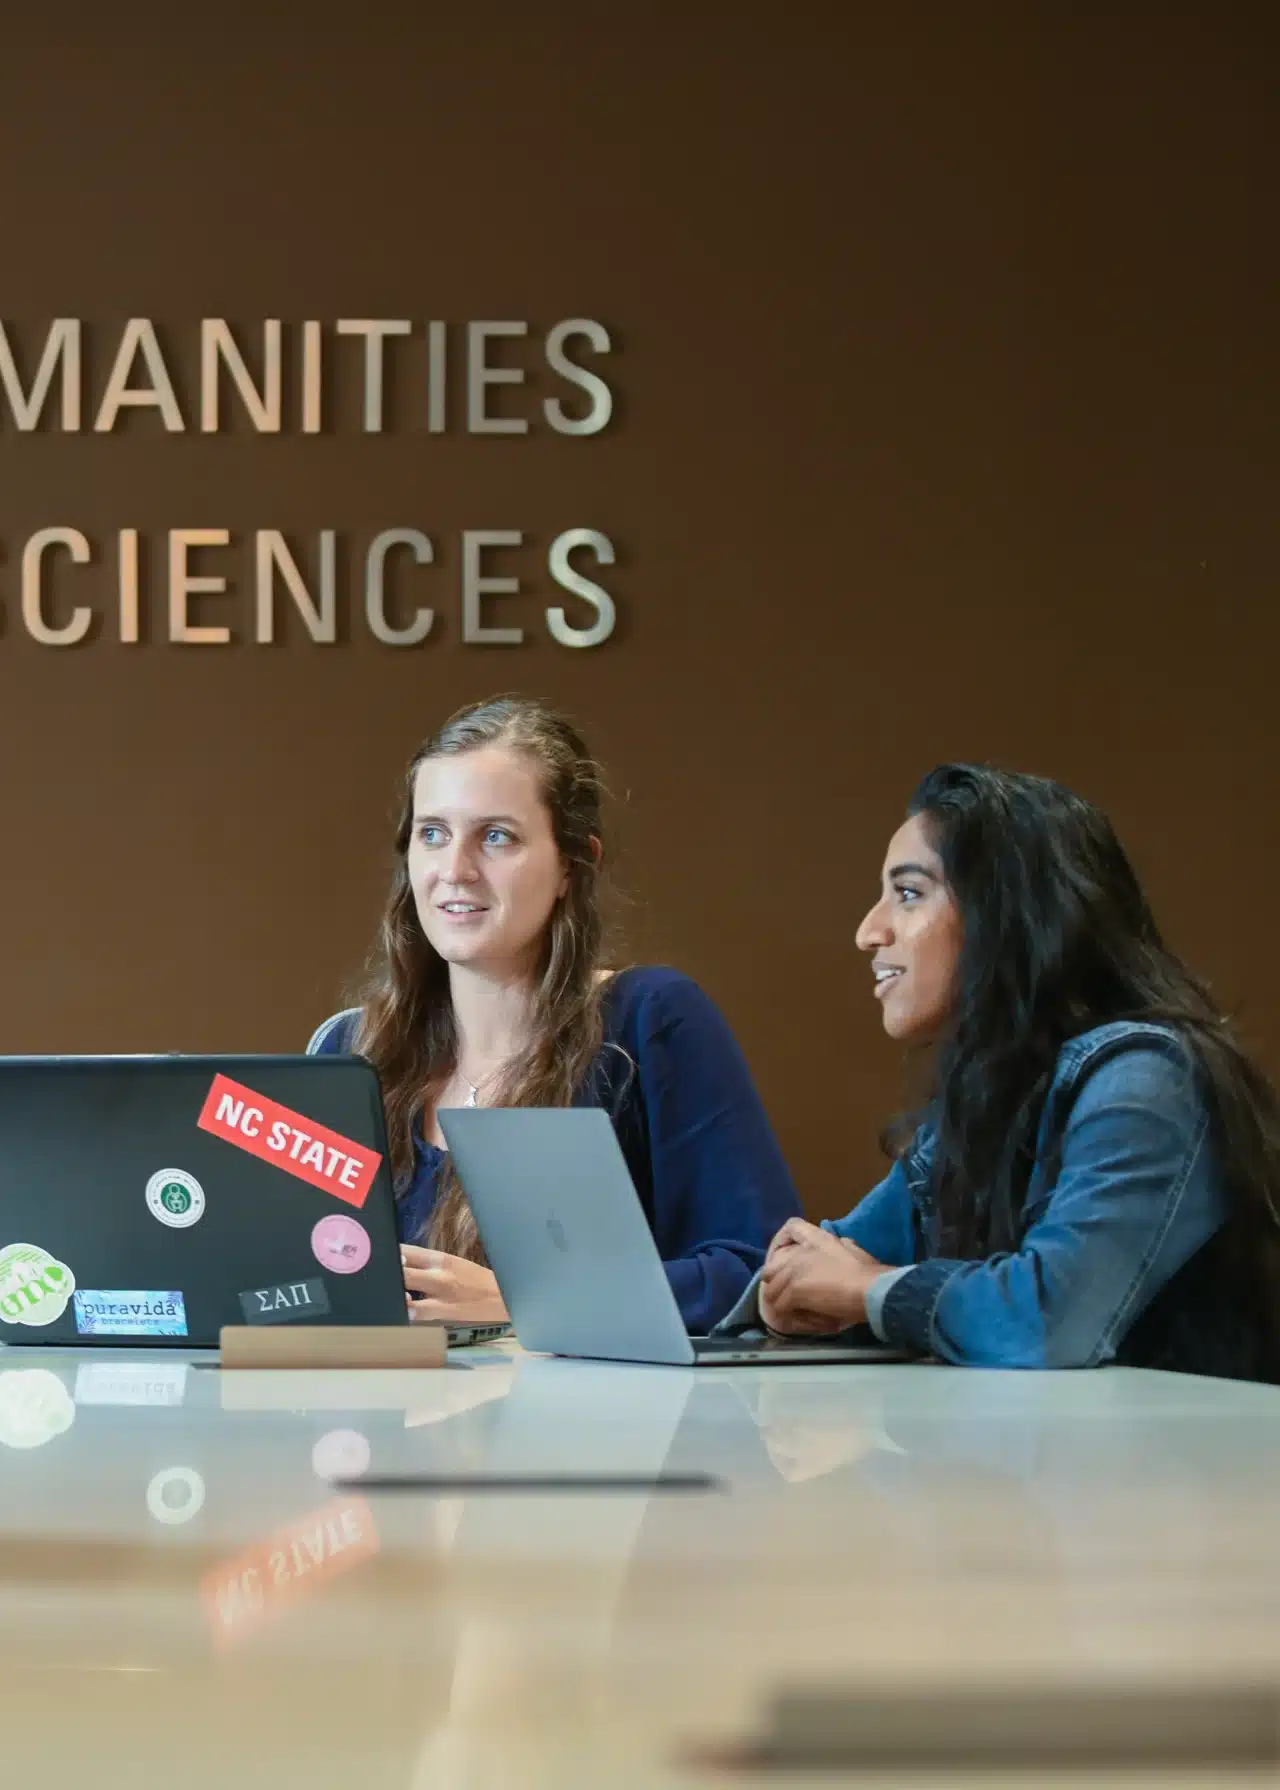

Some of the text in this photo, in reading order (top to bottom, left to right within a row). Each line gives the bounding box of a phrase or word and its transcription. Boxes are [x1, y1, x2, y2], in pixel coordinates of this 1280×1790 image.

[215, 1092, 364, 1189] NC STATE
[83, 1300, 177, 1318] puravida
